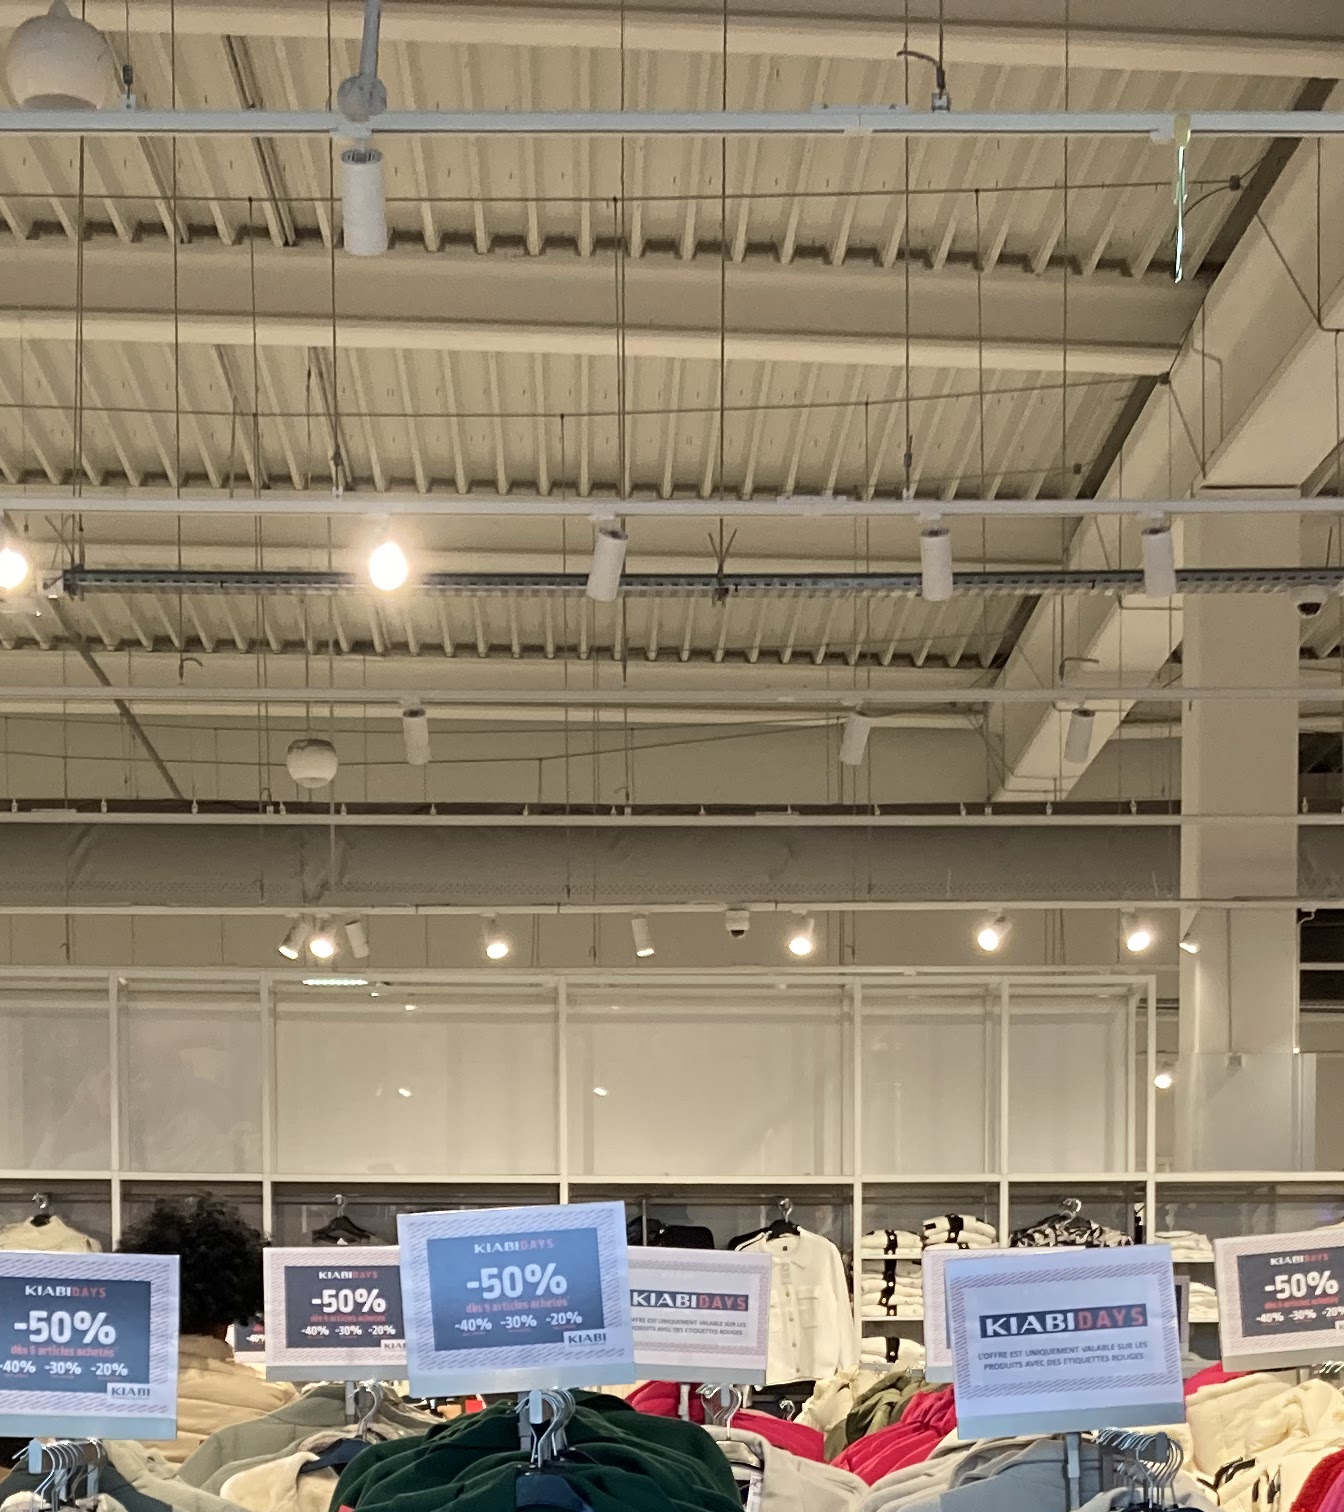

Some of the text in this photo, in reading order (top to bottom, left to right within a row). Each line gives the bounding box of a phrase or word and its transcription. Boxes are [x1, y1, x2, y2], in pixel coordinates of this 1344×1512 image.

[474, 1238, 554, 1254] KIABIDAYS
[466, 1262, 568, 1300] -50%
[1264, 1270, 1339, 1300] -50%
[25, 1284, 107, 1299] KIABIDAYS
[311, 1288, 387, 1314] -50%
[631, 1291, 747, 1310] KIABIDAYS
[13, 1310, 116, 1345] -50%
[301, 1325, 396, 1336] -40% -30% -20%
[455, 1311, 583, 1332] -40% -30% -20%
[985, 1306, 1145, 1337] KIABIDAYS
[568, 1332, 607, 1345] KIABI
[978, 1340, 1148, 1361] L'OFFRE EST UNIQUEMENT VALABLE SUR LES
[44, 1361, 82, 1375] -30%
[90, 1362, 129, 1377] -20%
[983, 1352, 1144, 1371] PRODUITS AVEC DES ETIQUETTES ROUGES
[110, 1386, 151, 1398] KIABI
